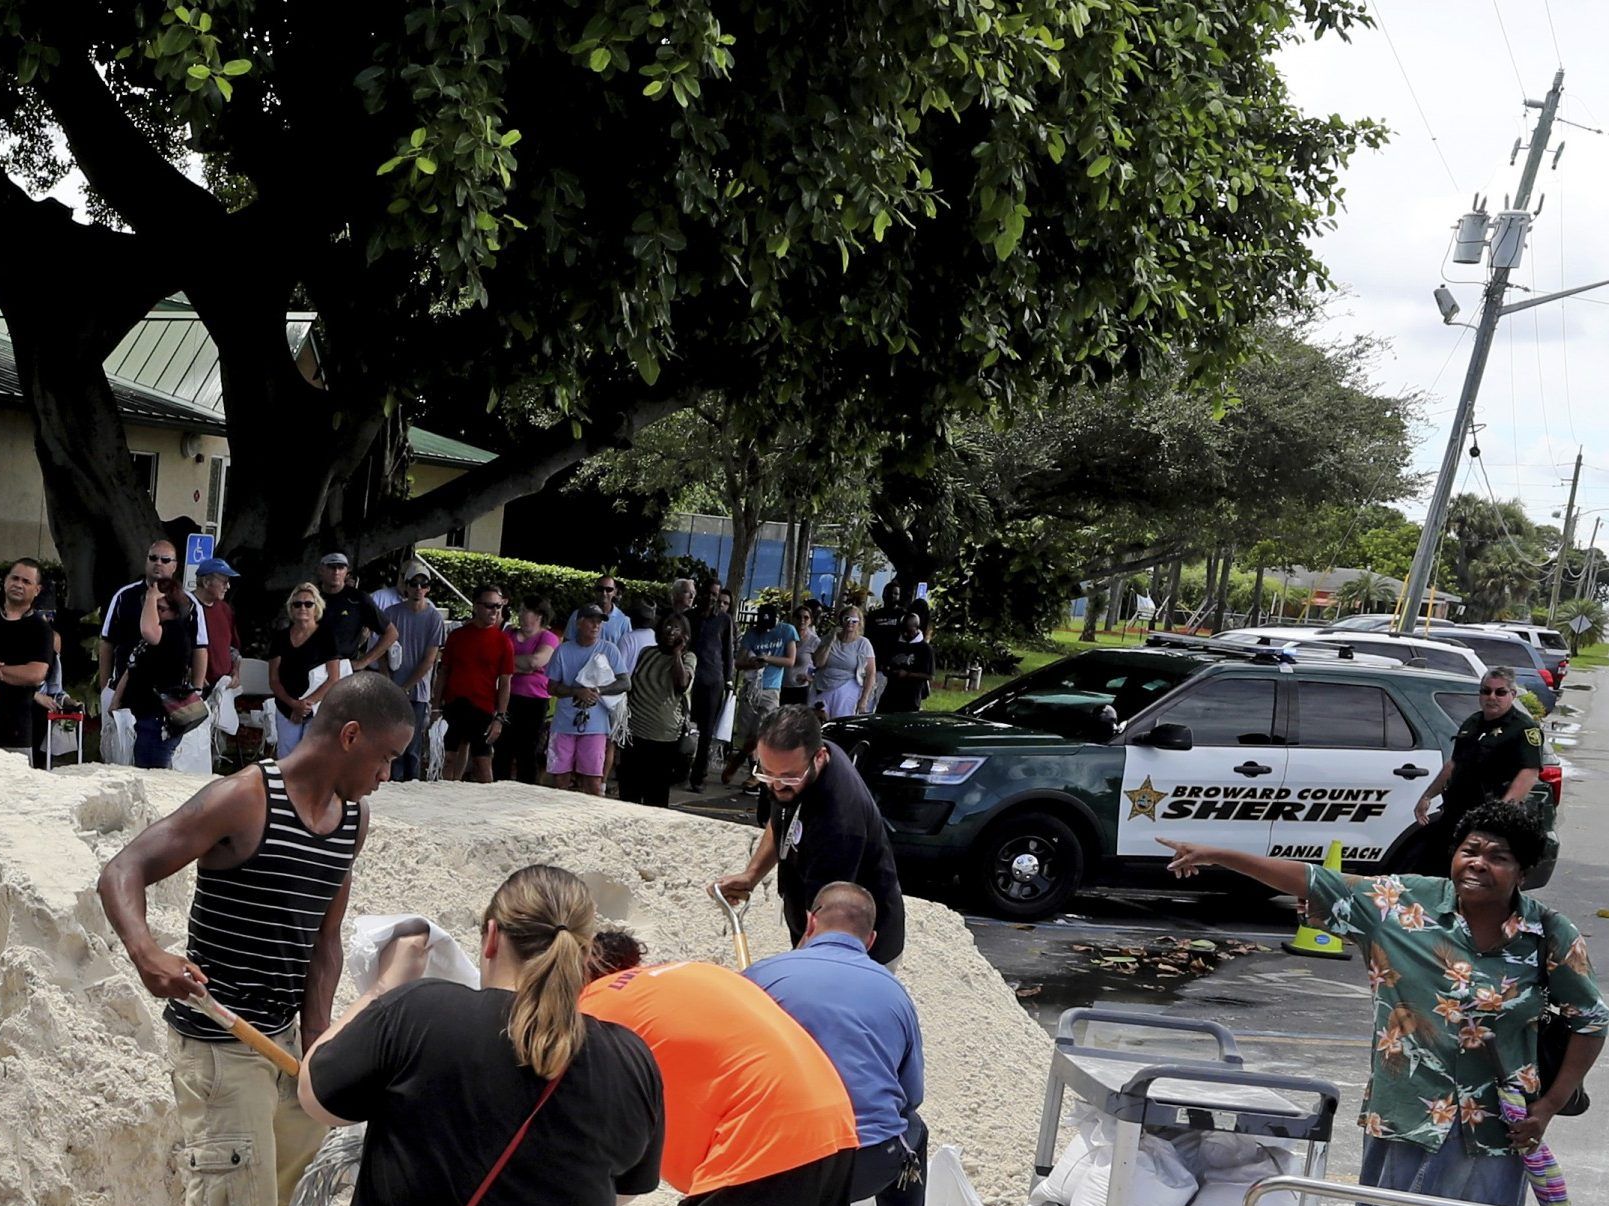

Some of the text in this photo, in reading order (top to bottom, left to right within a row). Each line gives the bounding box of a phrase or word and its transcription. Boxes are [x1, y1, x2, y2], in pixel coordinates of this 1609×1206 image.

[1172, 785, 1392, 801] BROWARD COUNTY
[1161, 800, 1387, 822] SHERIFF
[1269, 844, 1384, 860] DANIA EACH
